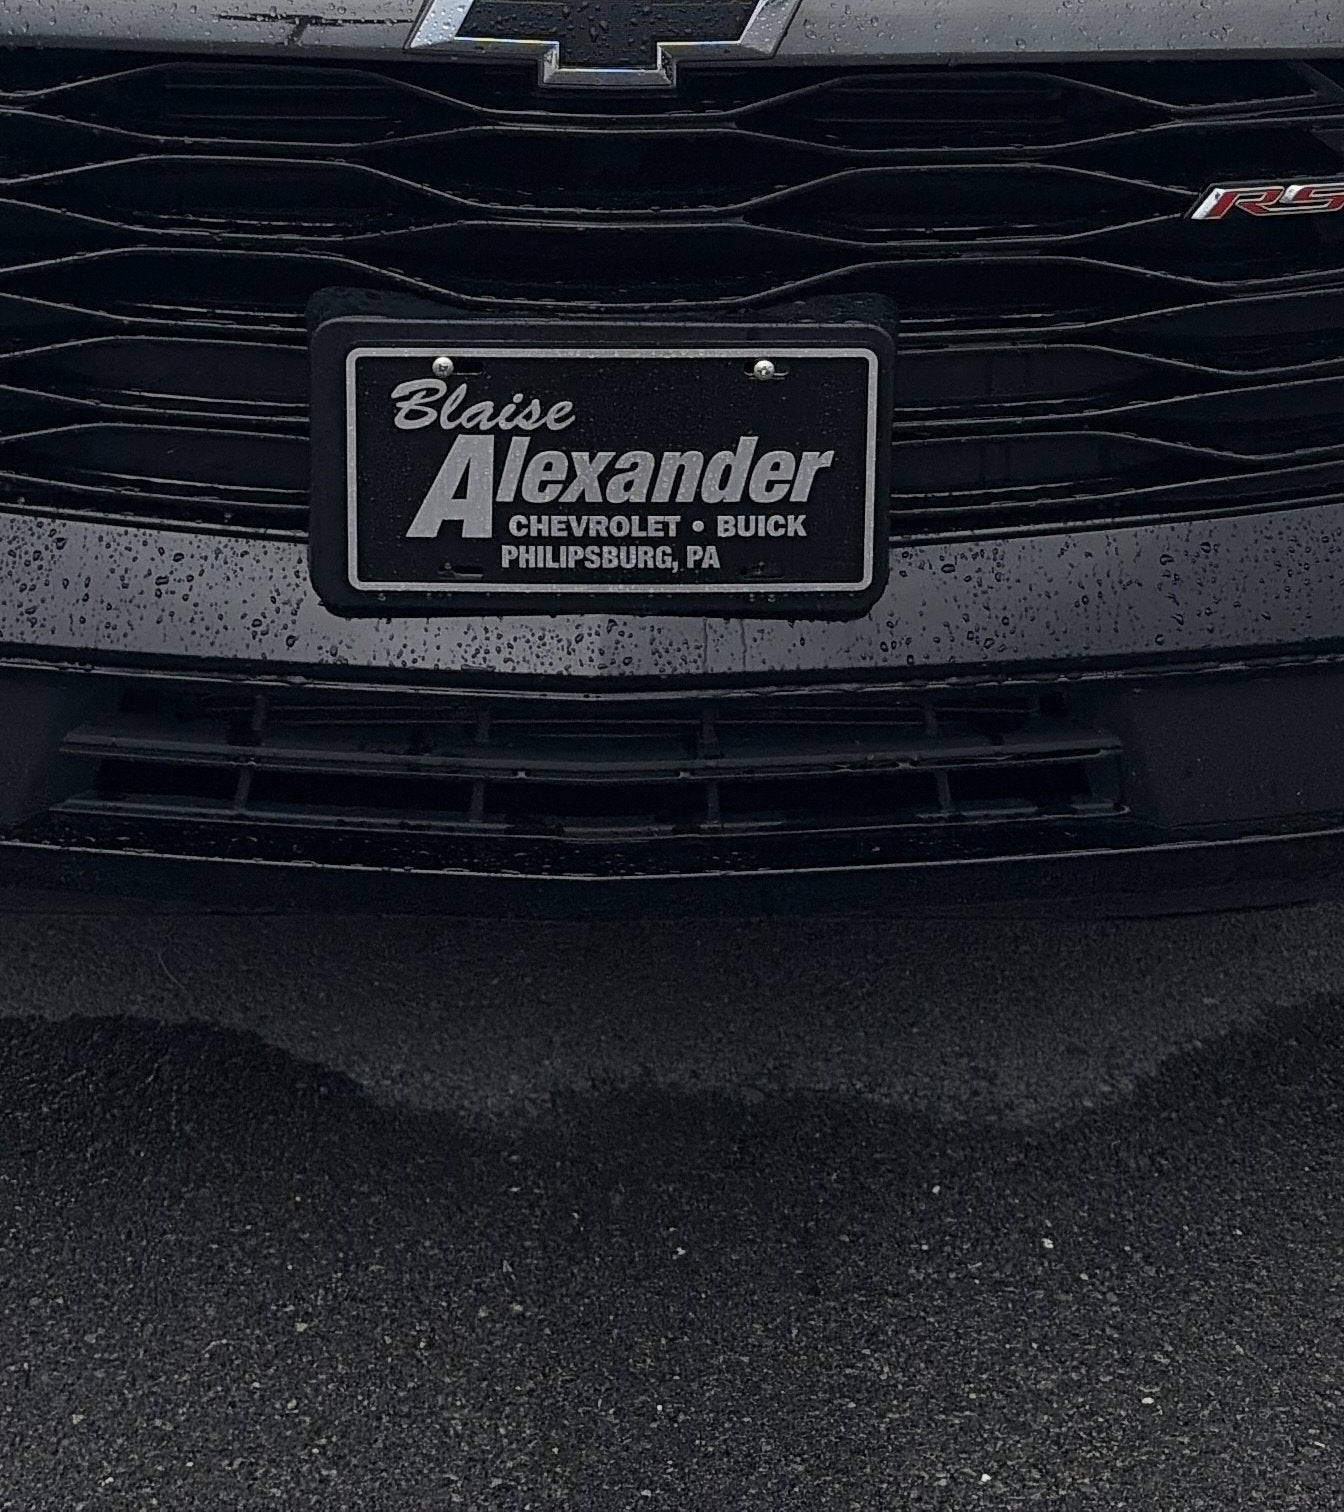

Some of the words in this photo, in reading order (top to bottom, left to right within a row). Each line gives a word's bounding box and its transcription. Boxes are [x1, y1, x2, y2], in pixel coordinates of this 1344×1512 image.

[390, 378, 576, 431] Blaise
[405, 433, 835, 539] Alexander
[508, 514, 681, 537] CHEVROLET
[716, 514, 807, 538] BUICK
[501, 544, 679, 574] PHILIPSBURG,
[686, 545, 721, 569] PA
